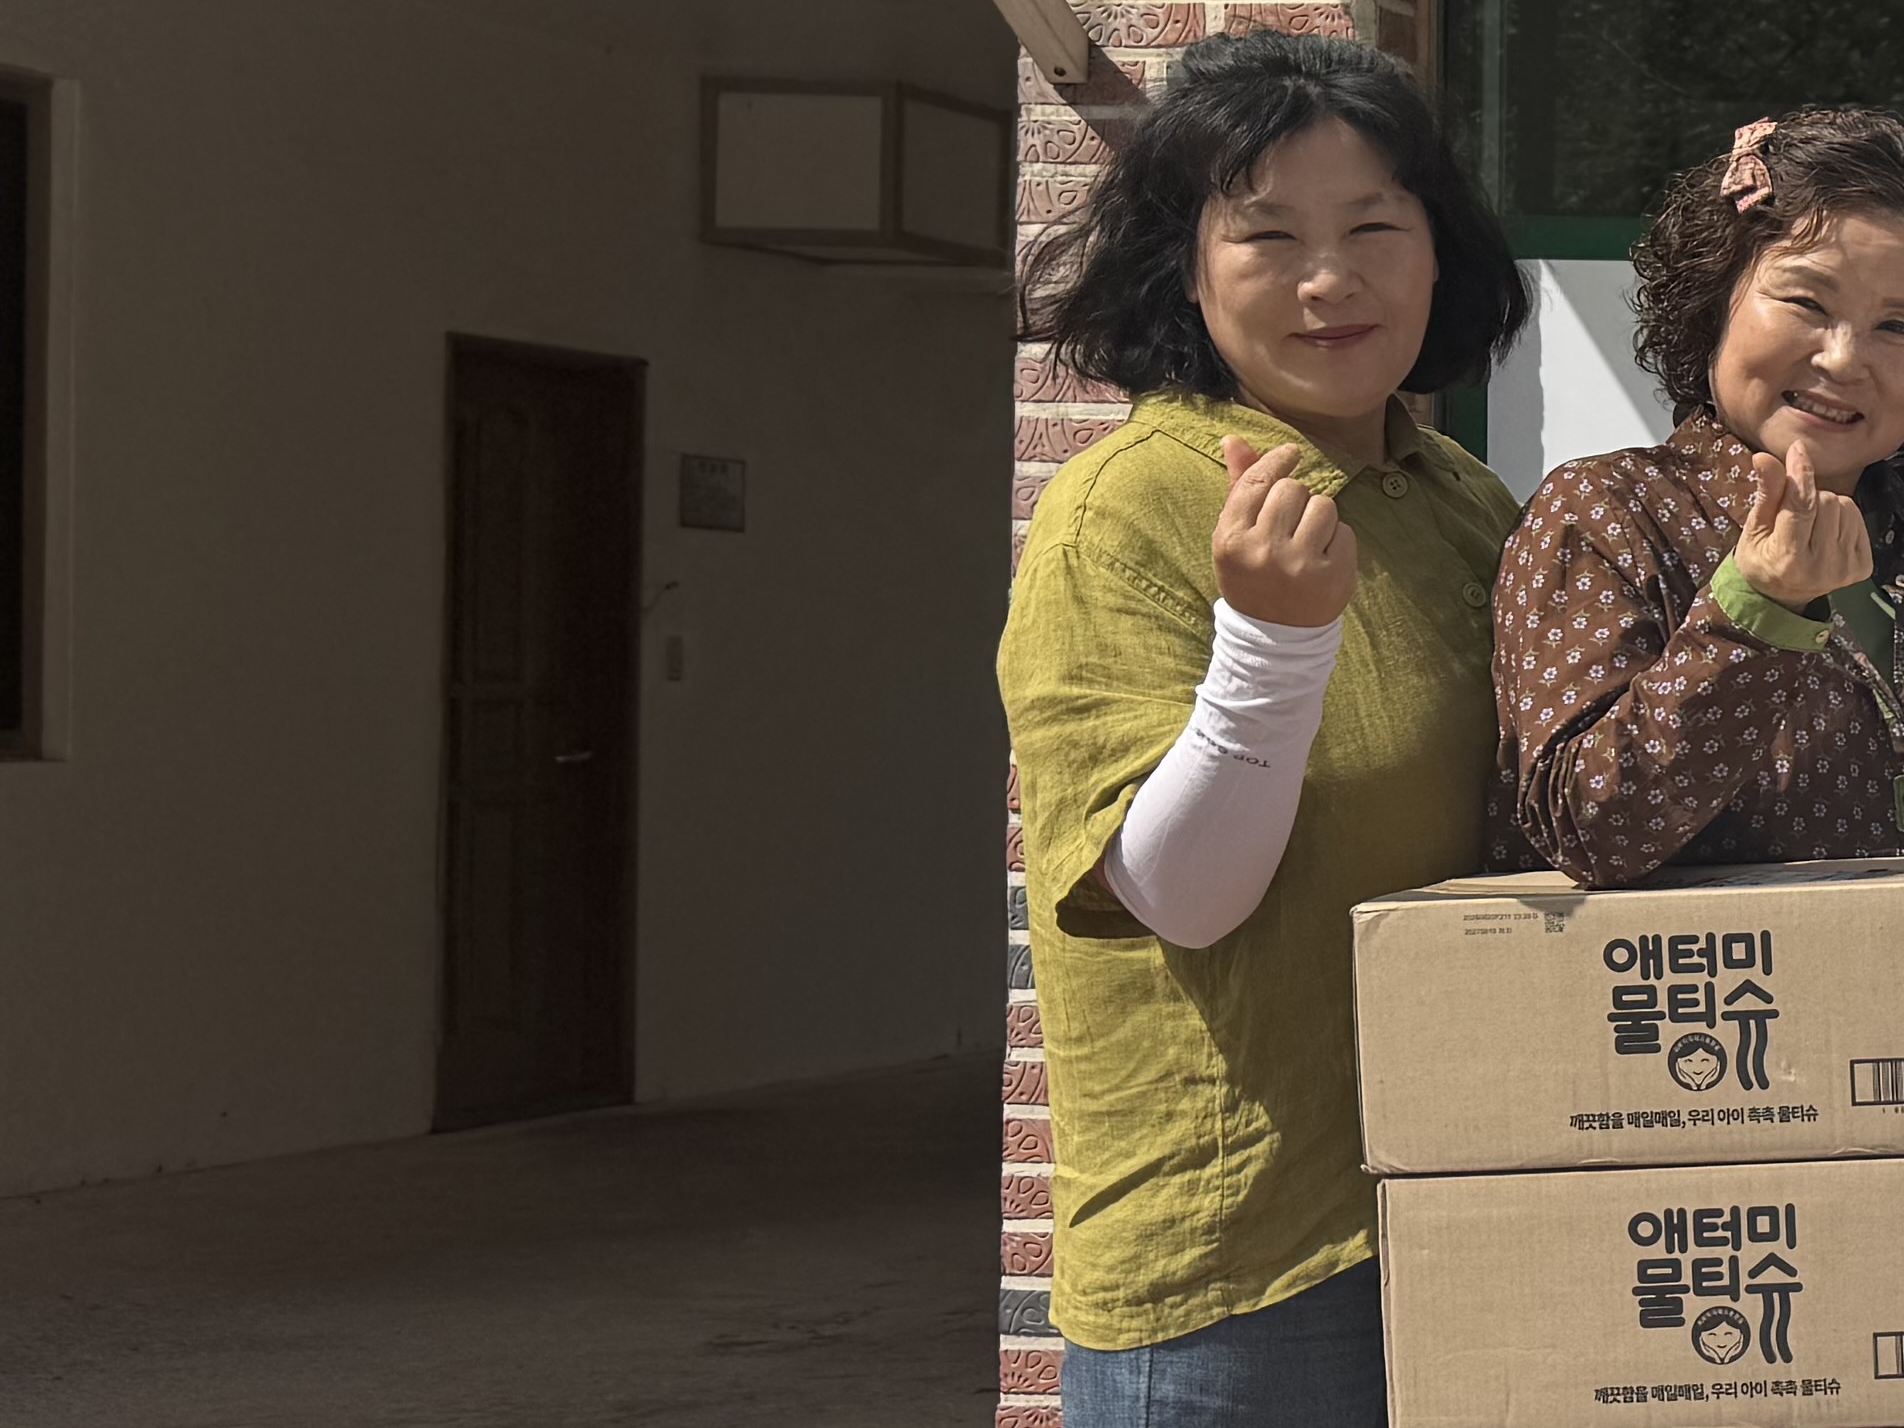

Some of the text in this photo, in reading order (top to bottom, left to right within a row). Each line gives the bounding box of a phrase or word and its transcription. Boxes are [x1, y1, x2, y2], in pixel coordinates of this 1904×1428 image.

[1604, 929, 1773, 979] 애터미
[1607, 980, 1779, 1092] 물티슈
[1627, 1109, 1686, 1129] 매일매일,
[1688, 1109, 1714, 1125] 우리
[1718, 1107, 1744, 1124] 아이
[1778, 1105, 1819, 1123] 물티슈
[1628, 1203, 1797, 1253] 애터미
[1631, 1252, 1803, 1364] 물티슈
[1651, 1383, 1709, 1402] 매일매일,
[1711, 1382, 1737, 1399] 우리
[1741, 1381, 1767, 1398] 아이
[1801, 1378, 1841, 1396] 물티슈
